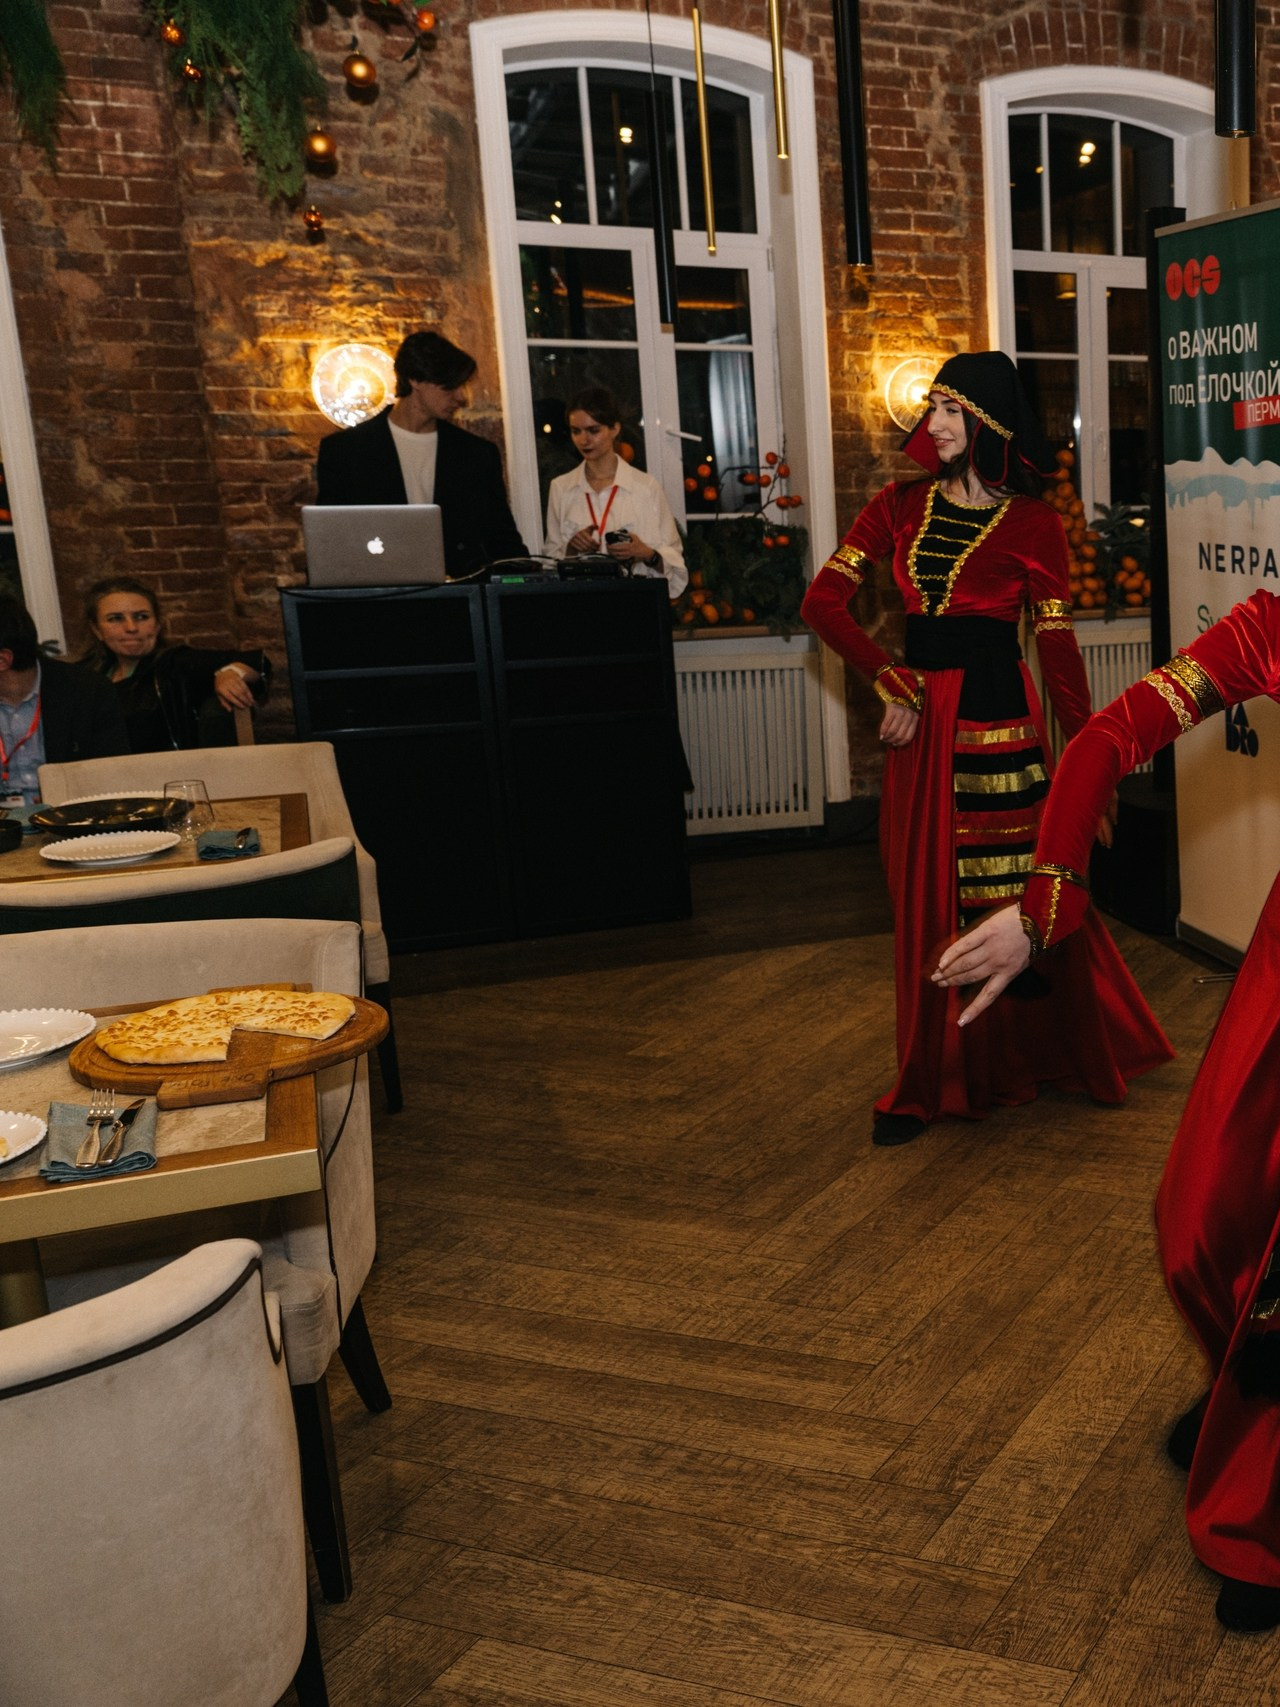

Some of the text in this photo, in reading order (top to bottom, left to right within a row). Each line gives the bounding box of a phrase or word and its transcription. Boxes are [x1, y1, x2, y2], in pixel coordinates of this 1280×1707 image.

[1165, 254, 1221, 301] OCS
[1180, 321, 1258, 360] ВАЖНОМ
[1198, 542, 1279, 579] NERPA
